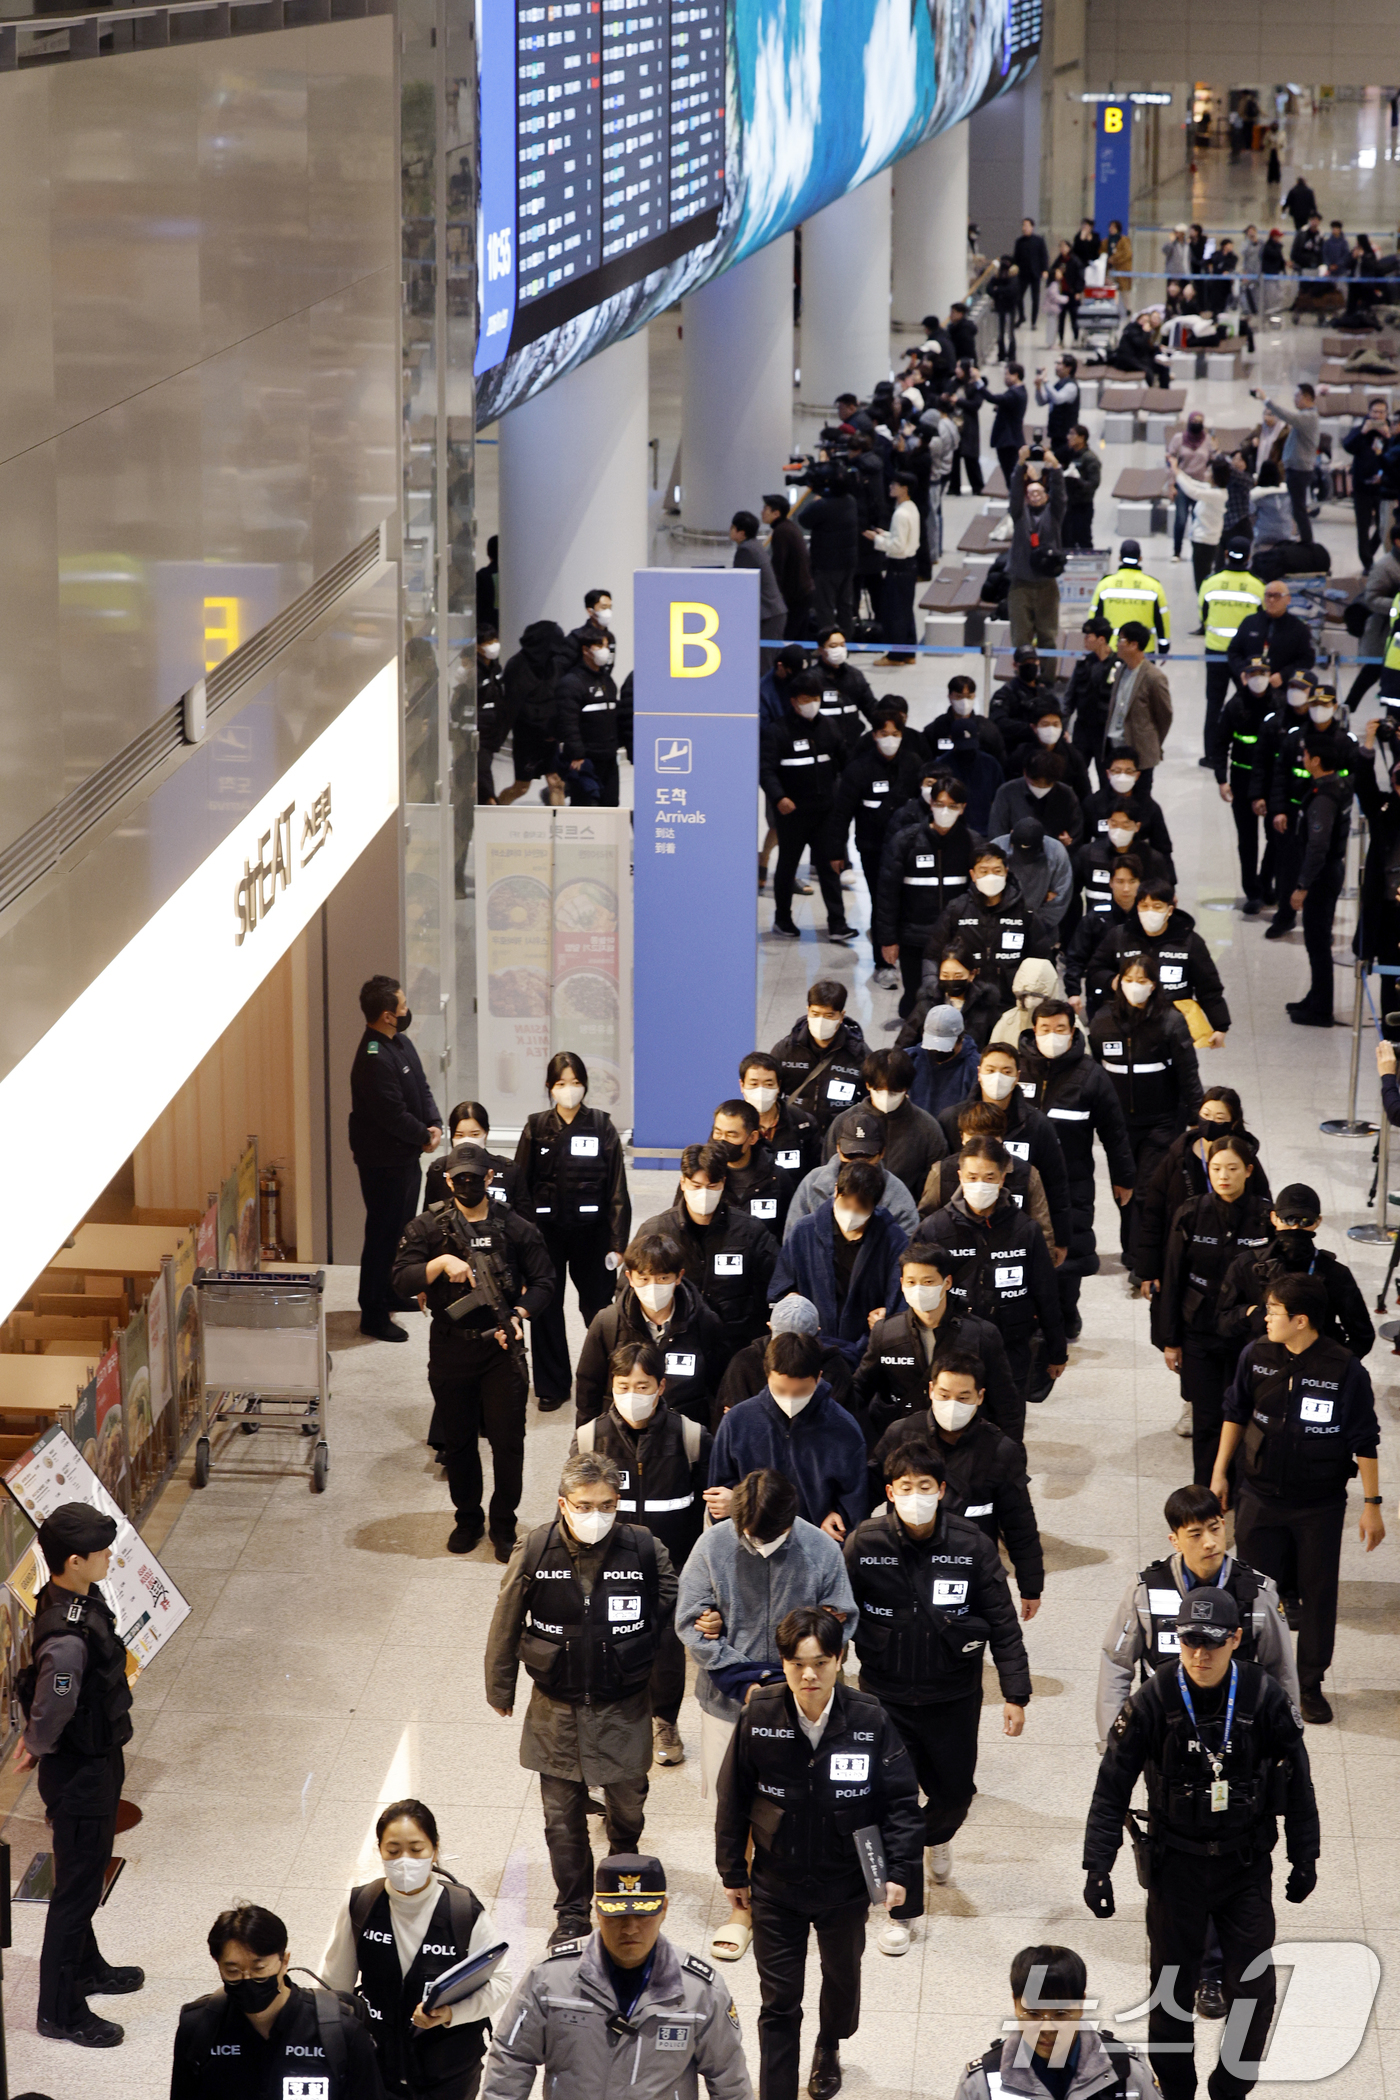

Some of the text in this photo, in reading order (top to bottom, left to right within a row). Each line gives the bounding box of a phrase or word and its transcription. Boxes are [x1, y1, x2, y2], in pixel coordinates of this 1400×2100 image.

[1104, 108, 1122, 133] B
[670, 602, 722, 678] B
[655, 788, 687, 806] 도착
[655, 810, 706, 824] Arrivals
[1000, 918, 1024, 926] POLIC
[1159, 952, 1188, 960] POLICE
[1163, 981, 1188, 991] POLICE
[831, 1064, 860, 1076] POLICE
[470, 1238, 492, 1247] LICE
[990, 1249, 1026, 1260] POLICE
[1000, 1287, 1028, 1298] POLIC
[880, 1356, 914, 1366] POLICE
[1302, 1378, 1338, 1390] POLICE
[1305, 1425, 1340, 1434] POLICE
[860, 1556, 898, 1566] POLICE
[932, 1554, 973, 1566] POLICE
[534, 1570, 572, 1579] OLICE
[612, 1620, 644, 1634] POLICE
[751, 1728, 796, 1738] POLICE
[834, 1787, 870, 1799] POLIC
[660, 2028, 687, 2040] 경찰
[210, 2044, 241, 2056] LICE
[285, 2046, 326, 2058] POLIC
